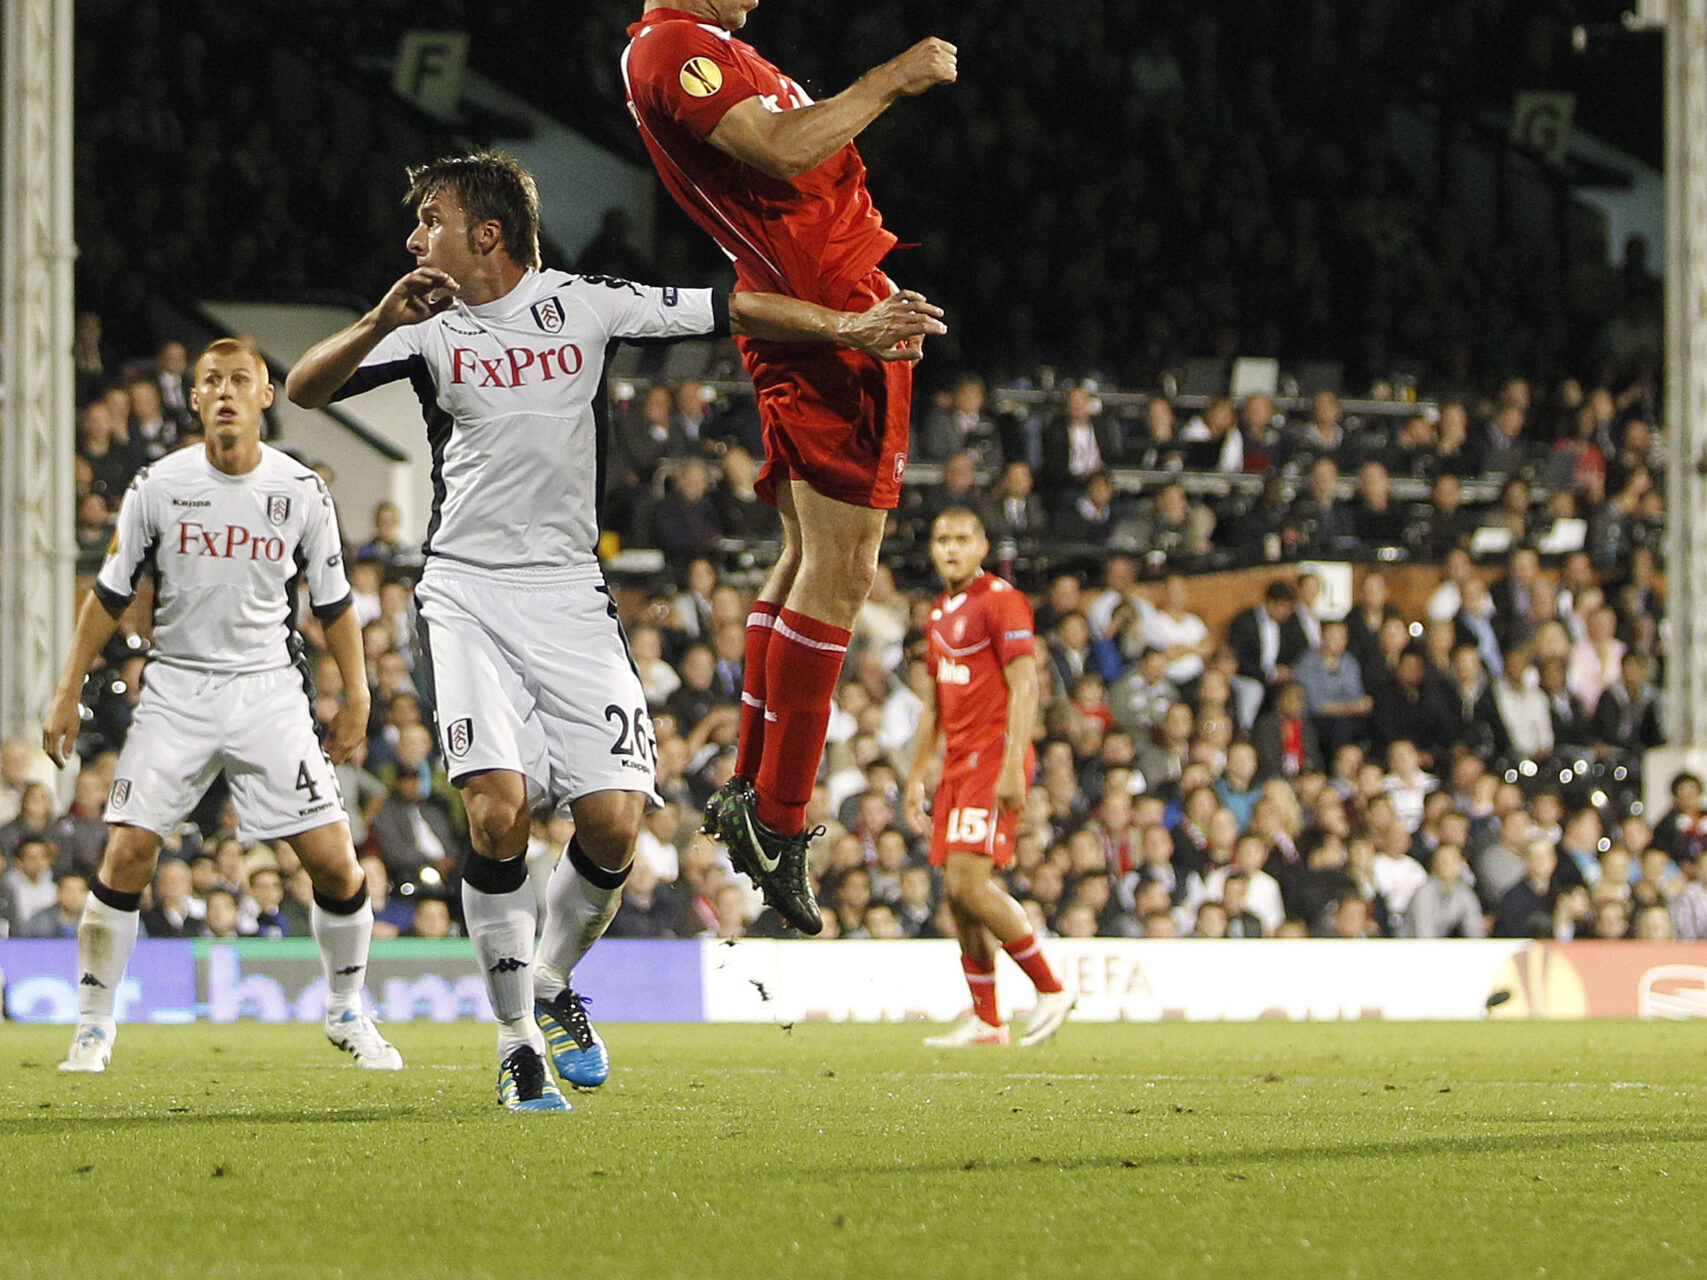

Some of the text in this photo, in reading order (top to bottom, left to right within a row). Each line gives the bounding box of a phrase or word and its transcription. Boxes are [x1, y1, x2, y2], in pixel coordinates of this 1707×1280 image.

[412, 44, 452, 96] F
[451, 343, 583, 389] FxPro
[177, 521, 285, 562] FxPro
[604, 704, 647, 760] 26
[296, 759, 323, 802] 4
[946, 806, 989, 843] 15
